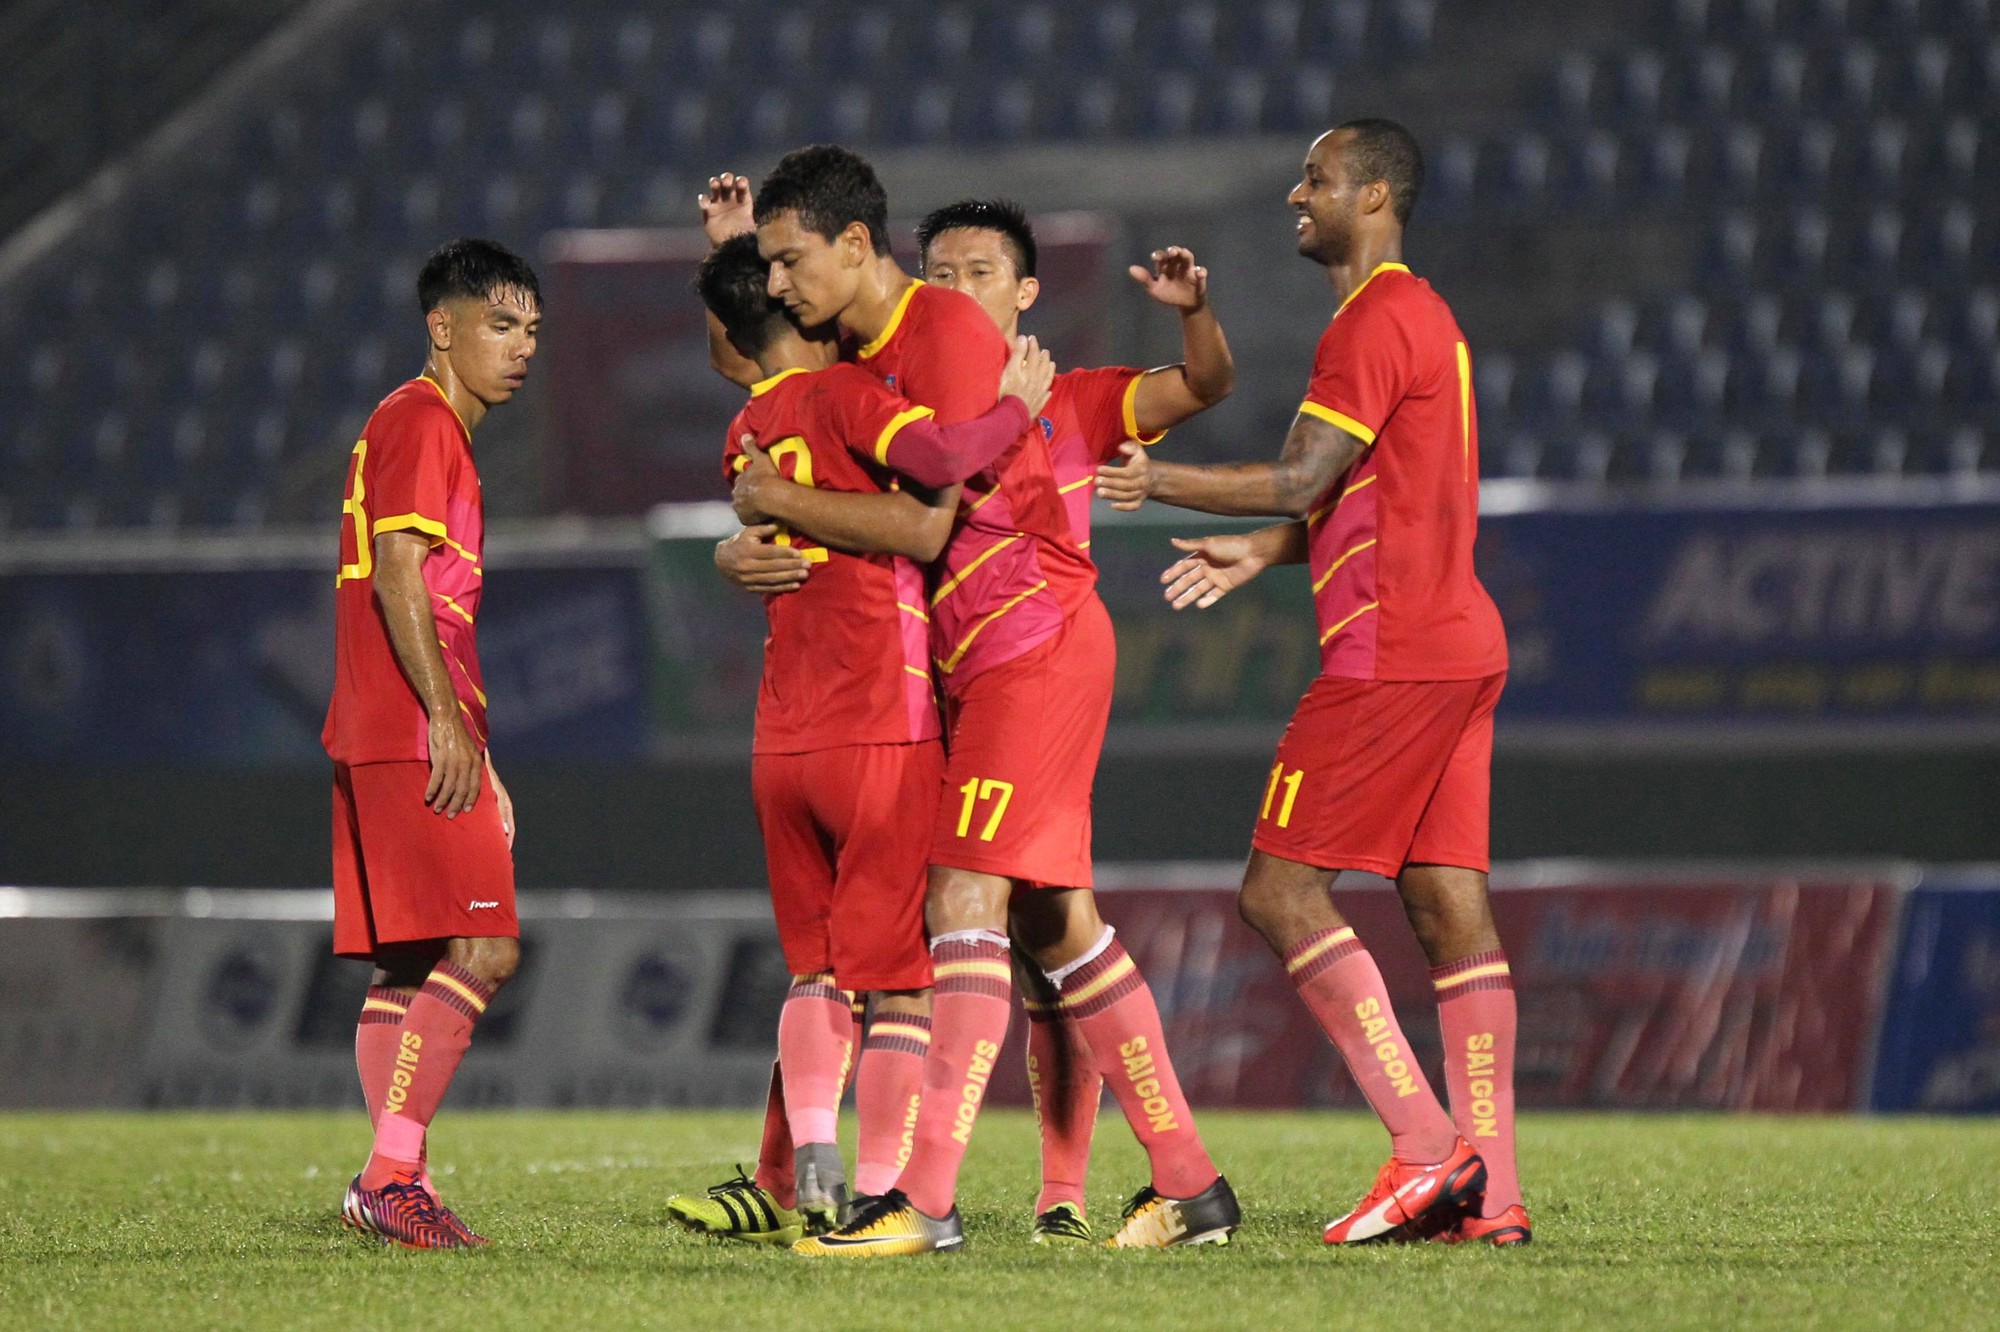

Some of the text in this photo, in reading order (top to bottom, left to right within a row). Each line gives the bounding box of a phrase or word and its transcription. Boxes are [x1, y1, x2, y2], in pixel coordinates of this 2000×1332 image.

[956, 776, 1014, 842] 17
[1261, 761, 1305, 829] 11
[385, 1030, 423, 1115] SAIGON
[951, 1039, 998, 1145] SAIGON
[1120, 1035, 1179, 1133] SAIGON
[1355, 996, 1420, 1098] SAIGON
[1467, 1032, 1498, 1137] SAIGON
